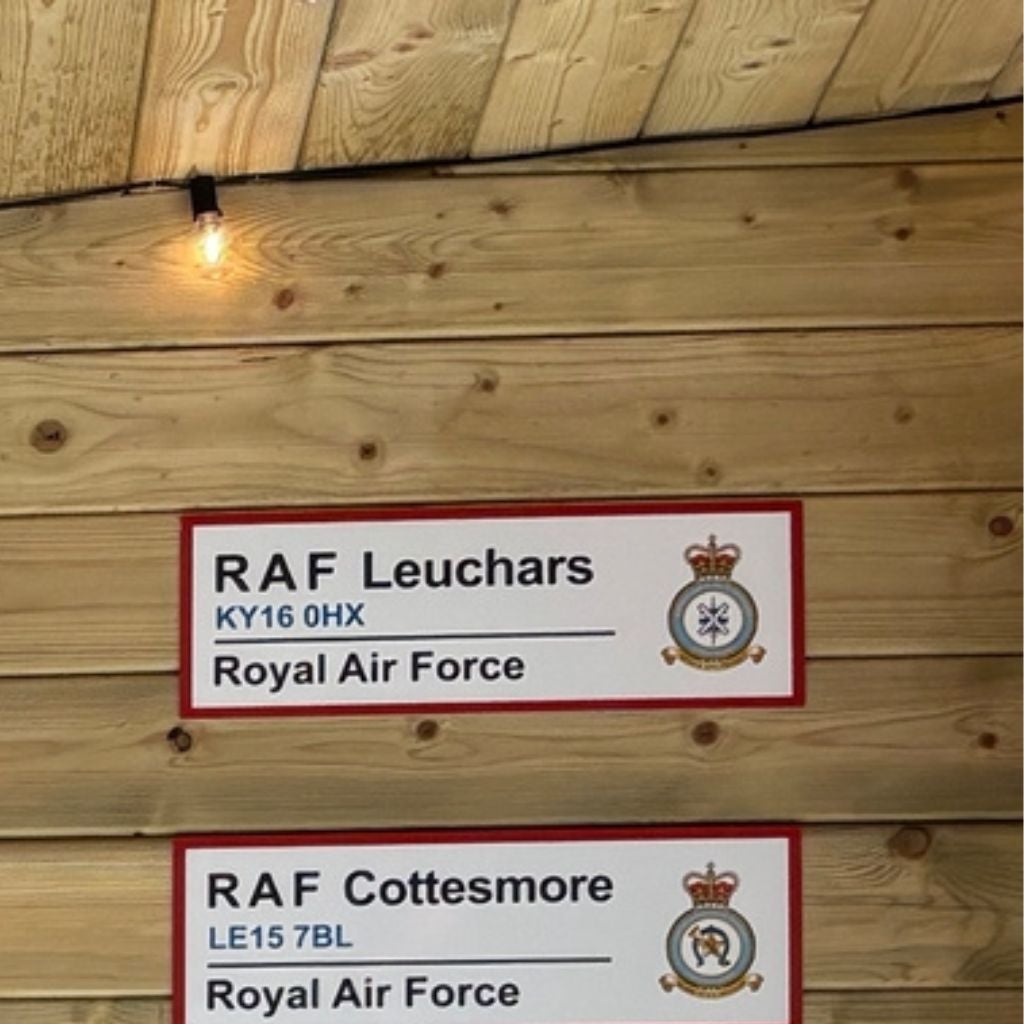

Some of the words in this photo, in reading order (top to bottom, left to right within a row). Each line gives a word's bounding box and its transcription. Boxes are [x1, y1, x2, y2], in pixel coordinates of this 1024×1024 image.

[214, 550, 338, 594] RAF
[362, 547, 595, 591] Leuchars
[215, 603, 295, 631] KY16
[303, 602, 365, 629] 0HX
[213, 652, 327, 692] Royal
[337, 651, 399, 685] Air
[410, 650, 526, 684] Force
[207, 870, 321, 910] RAF
[343, 868, 614, 908] Cottesmore
[208, 924, 285, 951] LE15
[293, 923, 354, 950] 7BL
[206, 977, 320, 1017] Royal
[331, 976, 393, 1011] Air
[404, 975, 521, 1009] Force
